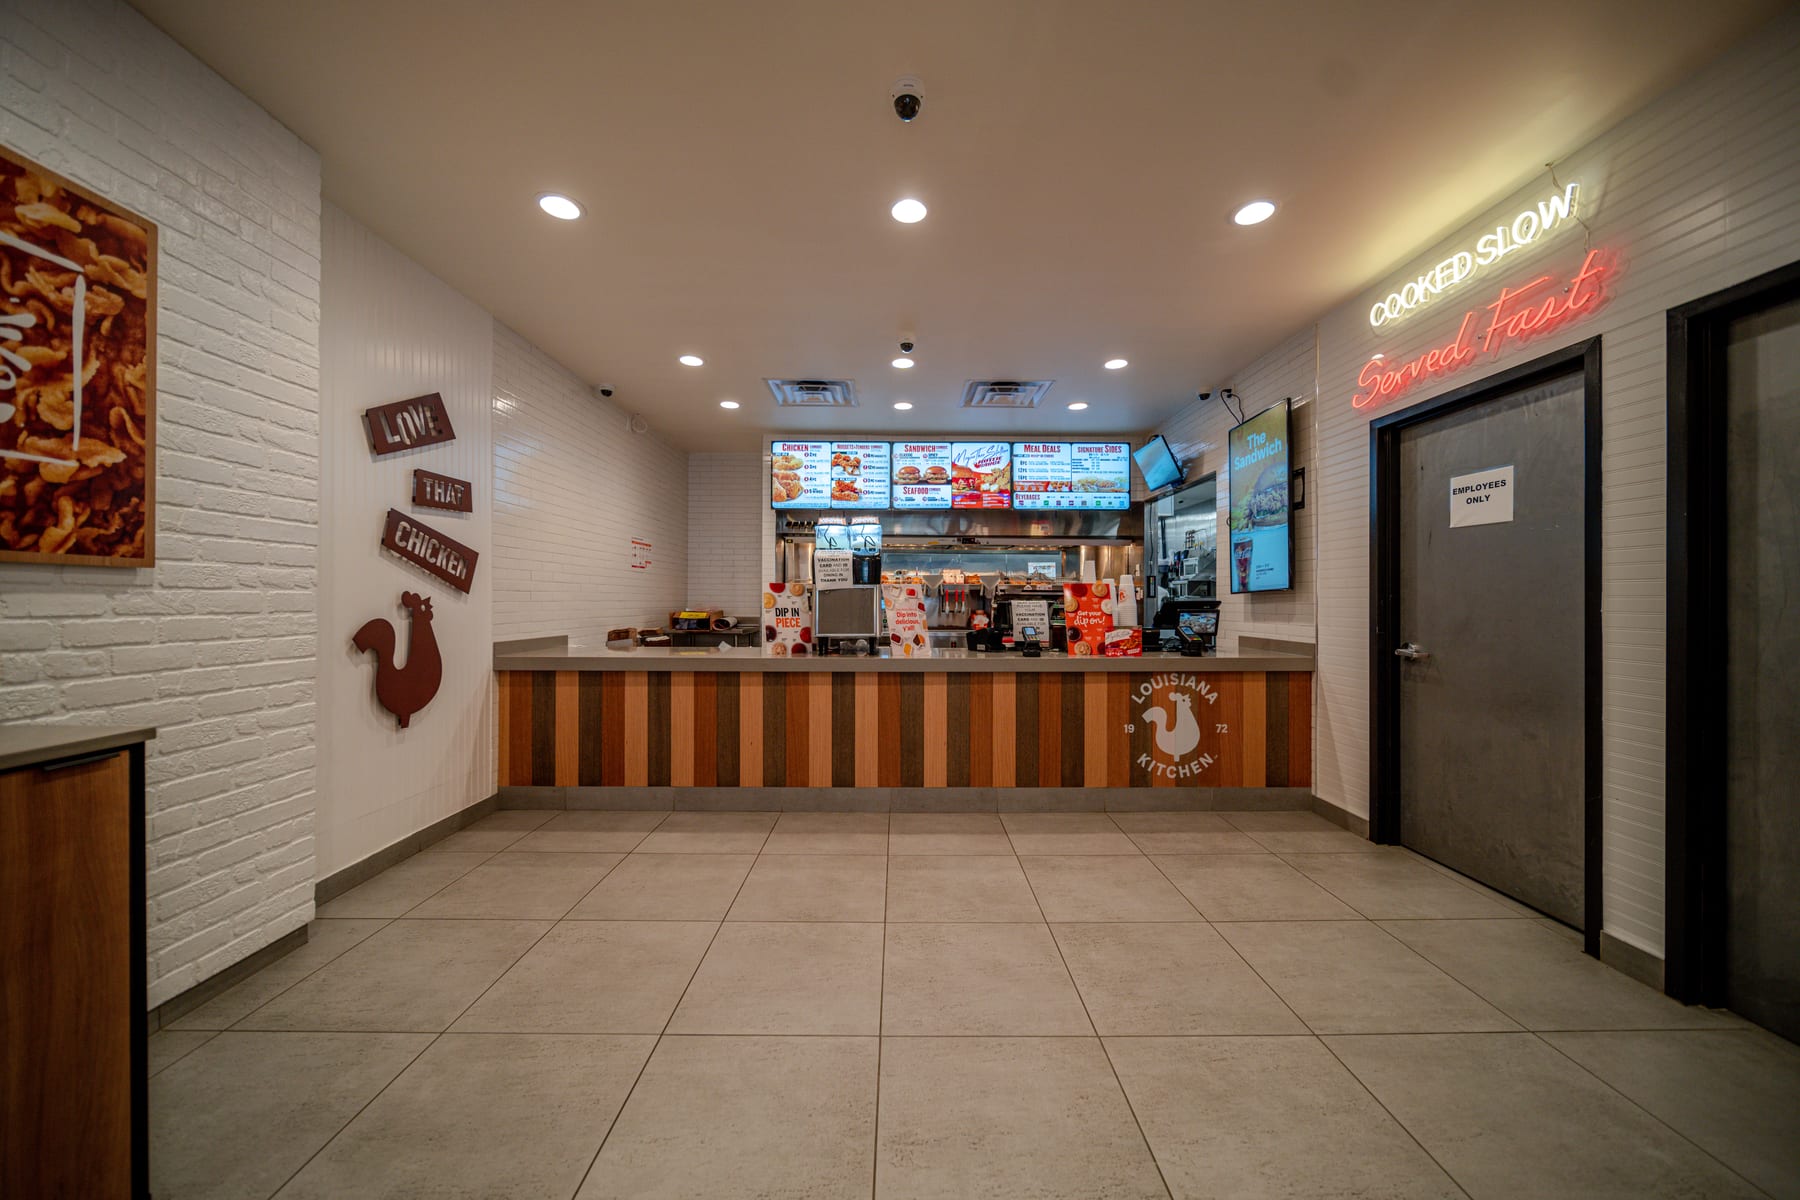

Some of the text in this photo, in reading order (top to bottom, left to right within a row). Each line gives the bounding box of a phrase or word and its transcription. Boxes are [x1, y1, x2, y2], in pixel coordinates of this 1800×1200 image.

[1370, 183, 1580, 327] COOKED SLOW
[1352, 249, 1606, 409] Served Fast
[379, 404, 443, 445] LOVE
[1247, 431, 1266, 450] The
[782, 443, 809, 452] CHICKEN
[904, 444, 936, 453] SANDWICH
[1023, 444, 1061, 453] MEAL DEALS
[1104, 444, 1122, 454] SIDES
[1234, 437, 1283, 471] Sandwich
[423, 477, 464, 506] THAT
[903, 486, 929, 495] SEAFOOD
[1452, 479, 1507, 496] EMPLOYEES
[1465, 494, 1491, 505] ONLY
[394, 521, 470, 580] CHICKEN
[775, 607, 800, 618] DIP IN
[896, 611, 906, 619] Dip
[775, 617, 801, 629] PIECE
[1073, 615, 1088, 628] dip
[1131, 672, 1219, 705] LOUISIANA
[1123, 723, 1229, 734] 19 72
[1136, 752, 1214, 779] KITCHEN
